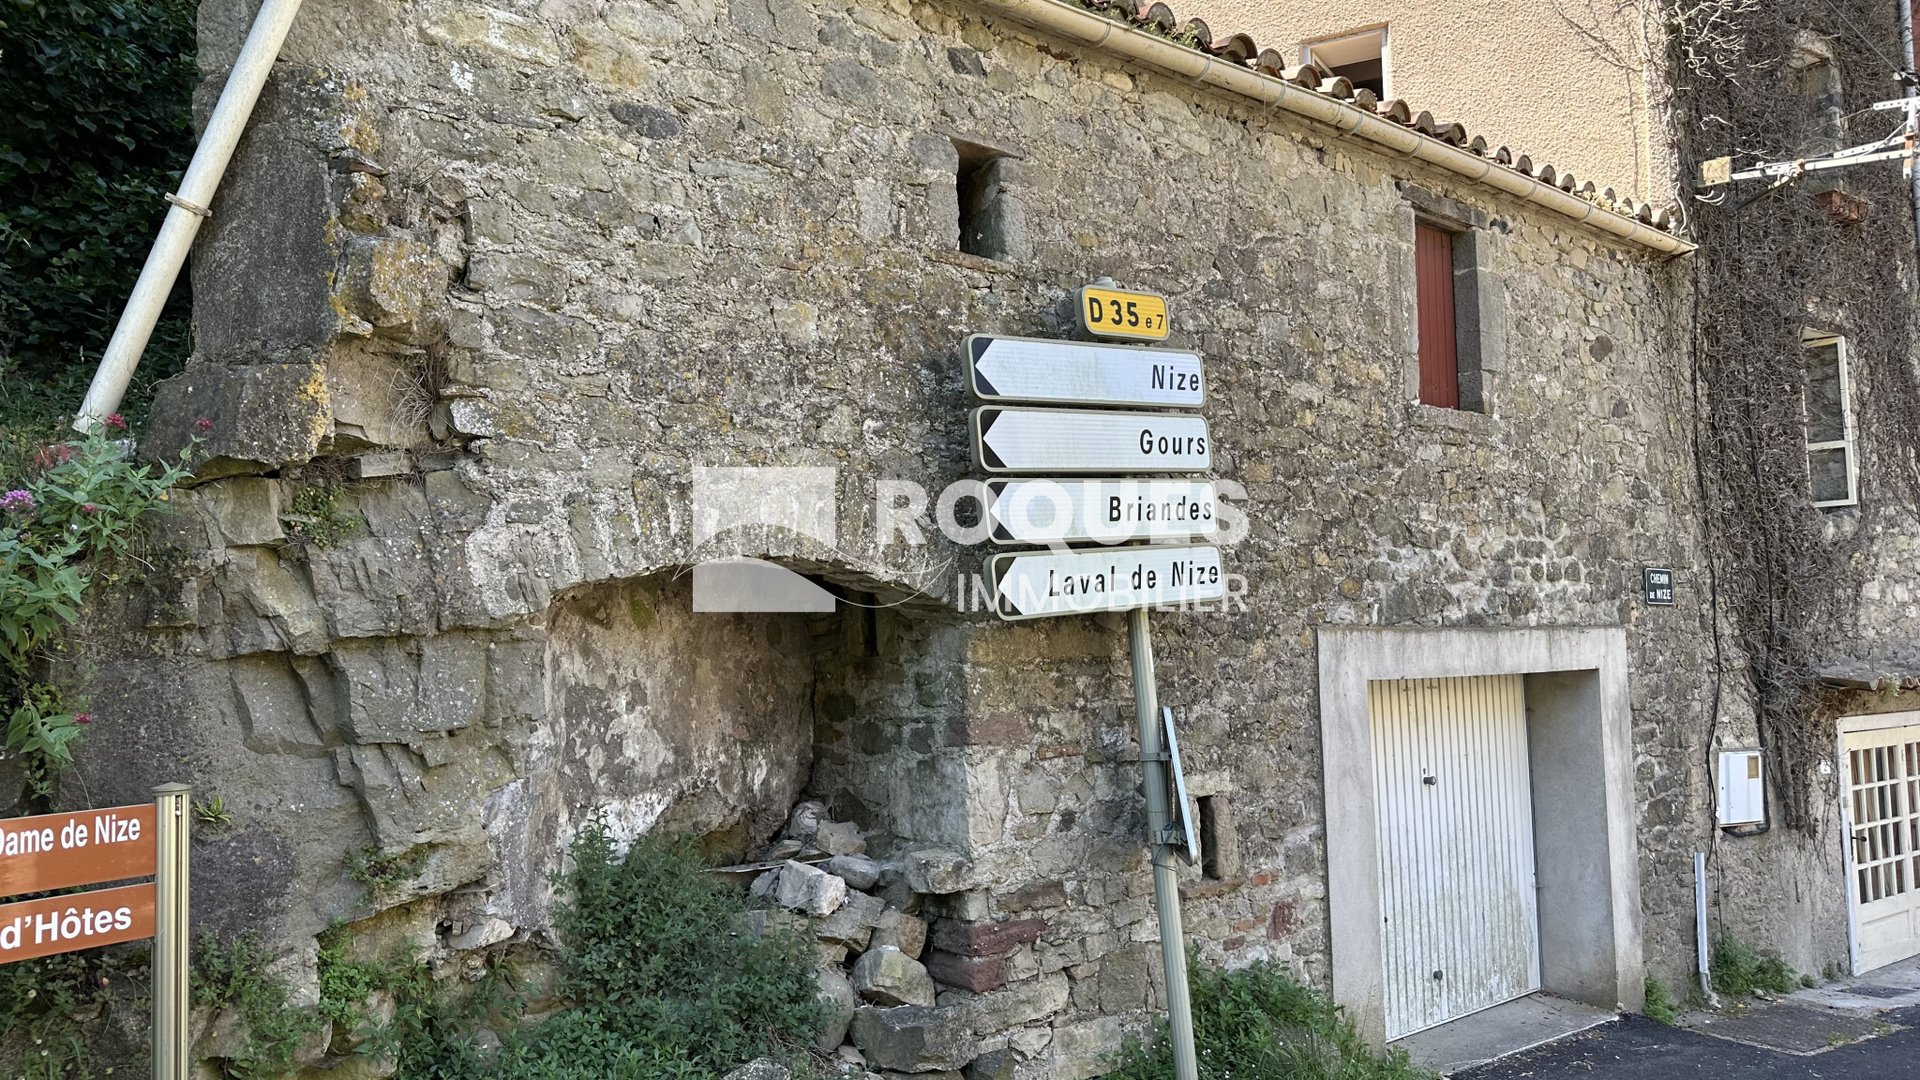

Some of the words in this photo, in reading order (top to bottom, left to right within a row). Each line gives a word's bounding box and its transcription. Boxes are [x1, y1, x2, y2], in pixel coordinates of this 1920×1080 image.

[1088, 297, 1104, 323] D
[1110, 299, 1139, 327] 35
[1151, 364, 1200, 391] Nize
[1139, 429, 1206, 455] Gours
[1109, 496, 1212, 522] Briandes
[1049, 566, 1116, 597] Laval
[1132, 564, 1157, 591] de
[1171, 560, 1219, 587] Nize
[1650, 573, 1669, 584] CHEMIN
[1656, 589, 1671, 599] NIZE
[0, 826, 55, 856] ame
[60, 819, 88, 850] de
[95, 814, 141, 845] Nize
